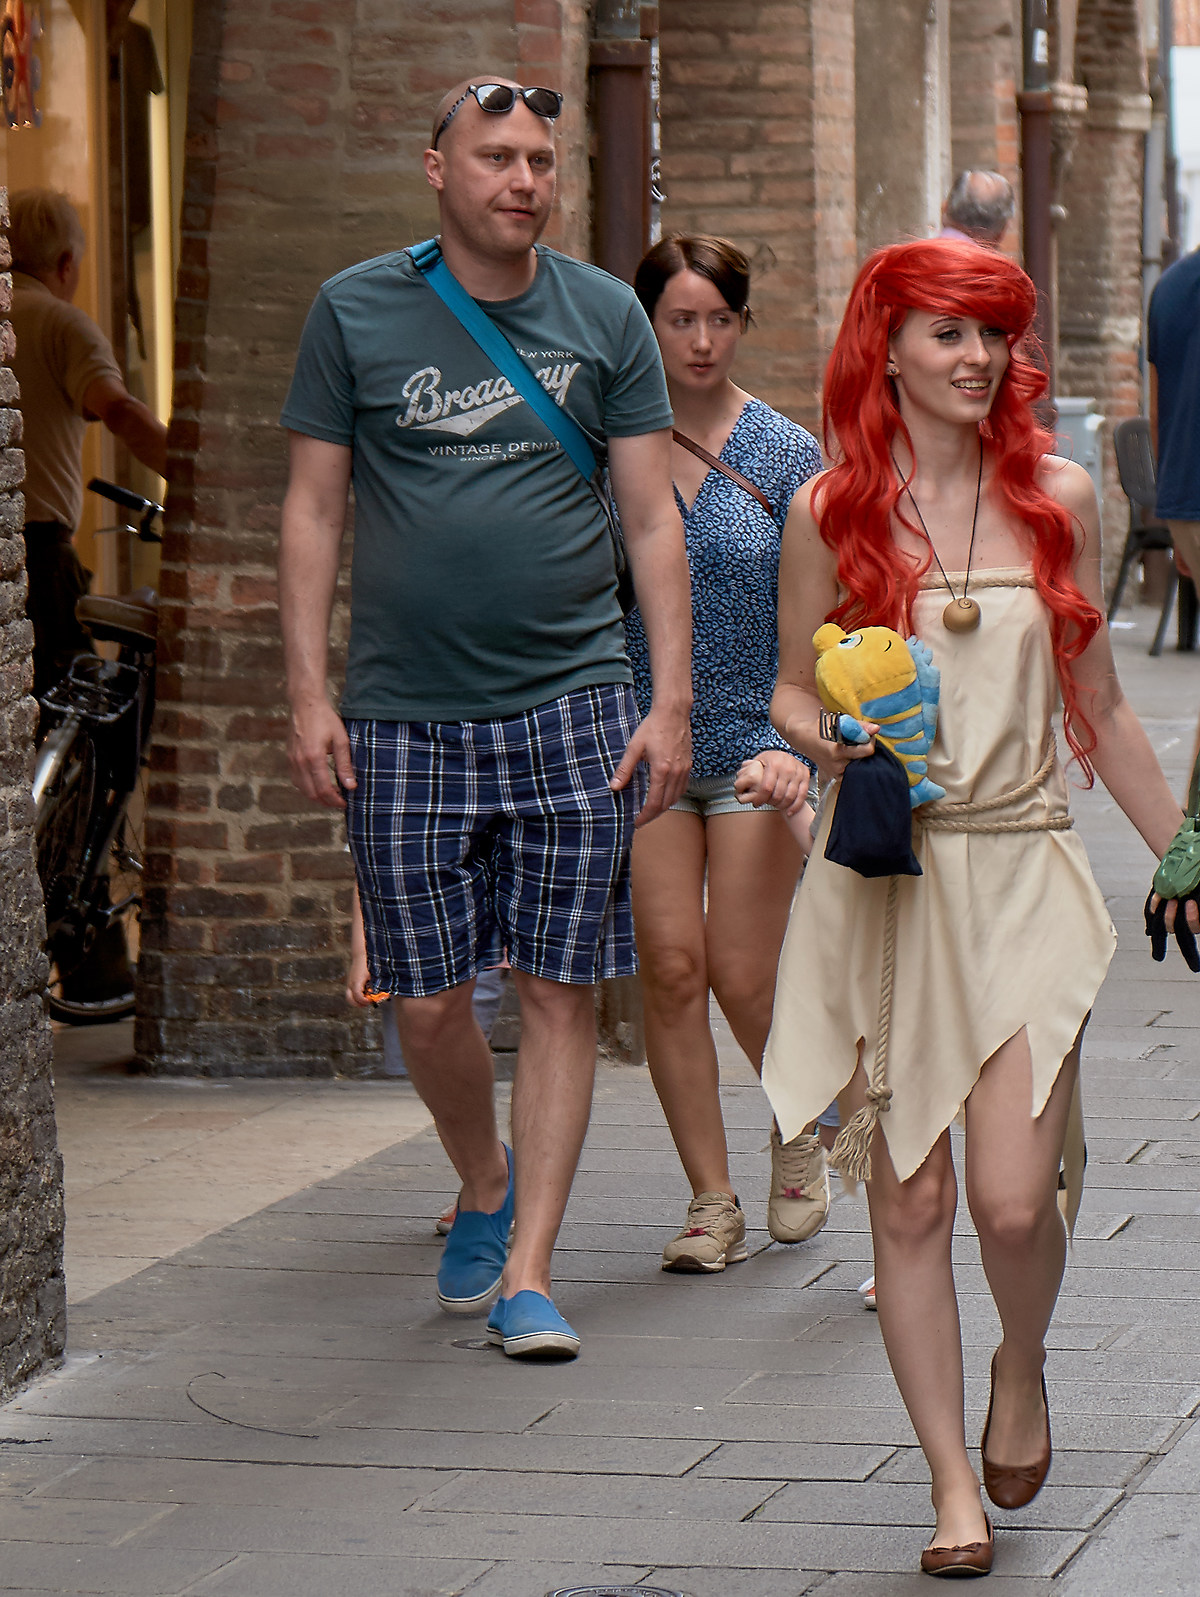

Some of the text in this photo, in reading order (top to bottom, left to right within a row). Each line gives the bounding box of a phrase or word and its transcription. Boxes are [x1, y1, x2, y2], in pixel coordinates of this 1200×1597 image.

[516, 348, 574, 359] EW YORK
[428, 440, 561, 456] VINTAGE DENIM
